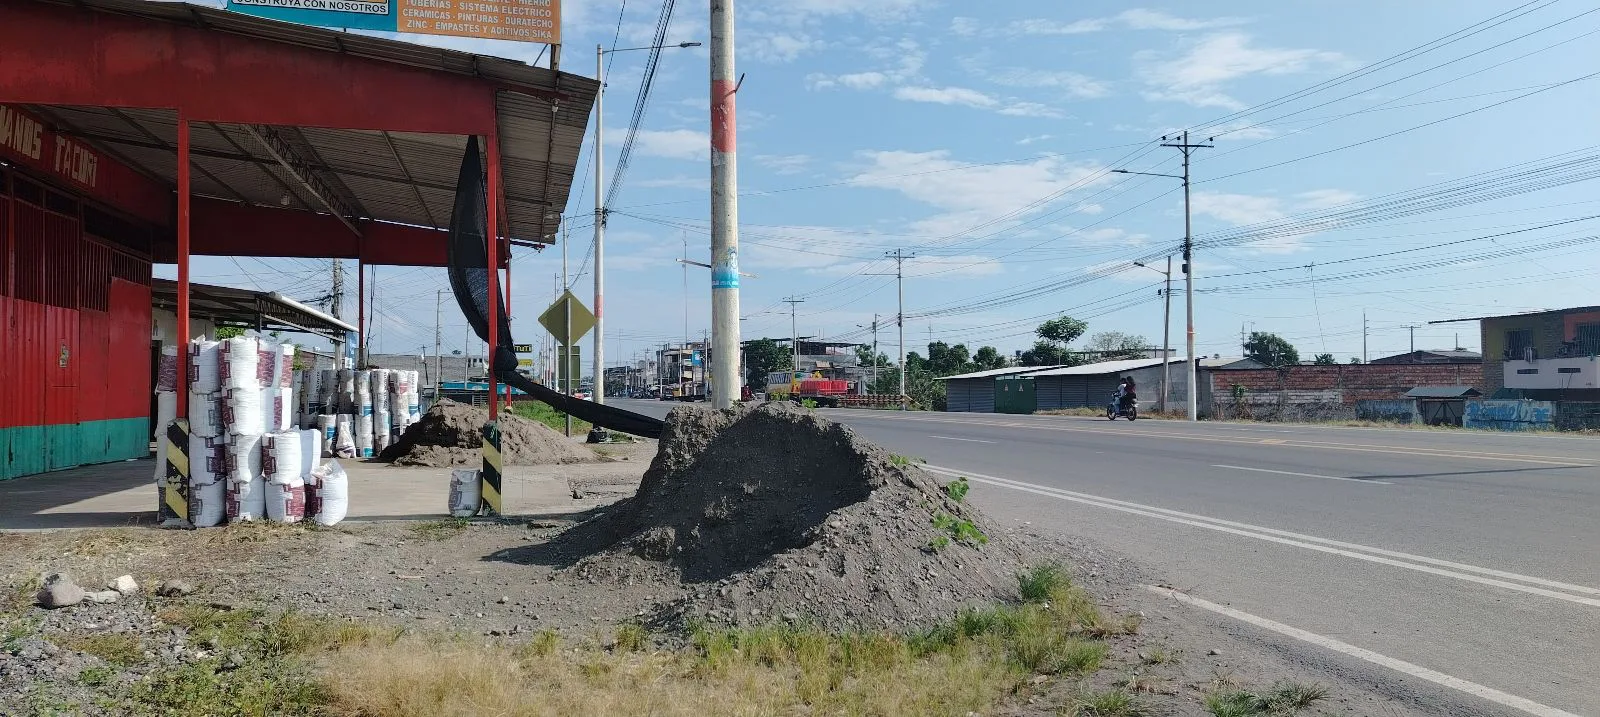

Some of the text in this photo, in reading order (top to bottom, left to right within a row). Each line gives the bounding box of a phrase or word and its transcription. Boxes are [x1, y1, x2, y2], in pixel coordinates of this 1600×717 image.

[303, 0, 326, 8] CON
[329, 2, 386, 13] NOSOTROS
[406, 0, 552, 17] TUBERIAS SISTEMA ELECTRICO
[402, 8, 553, 28] CERAMICAS PINTURAS DURATECHO
[406, 19, 553, 39] ZINC EMPASTES Y ADITIVOS SIKA
